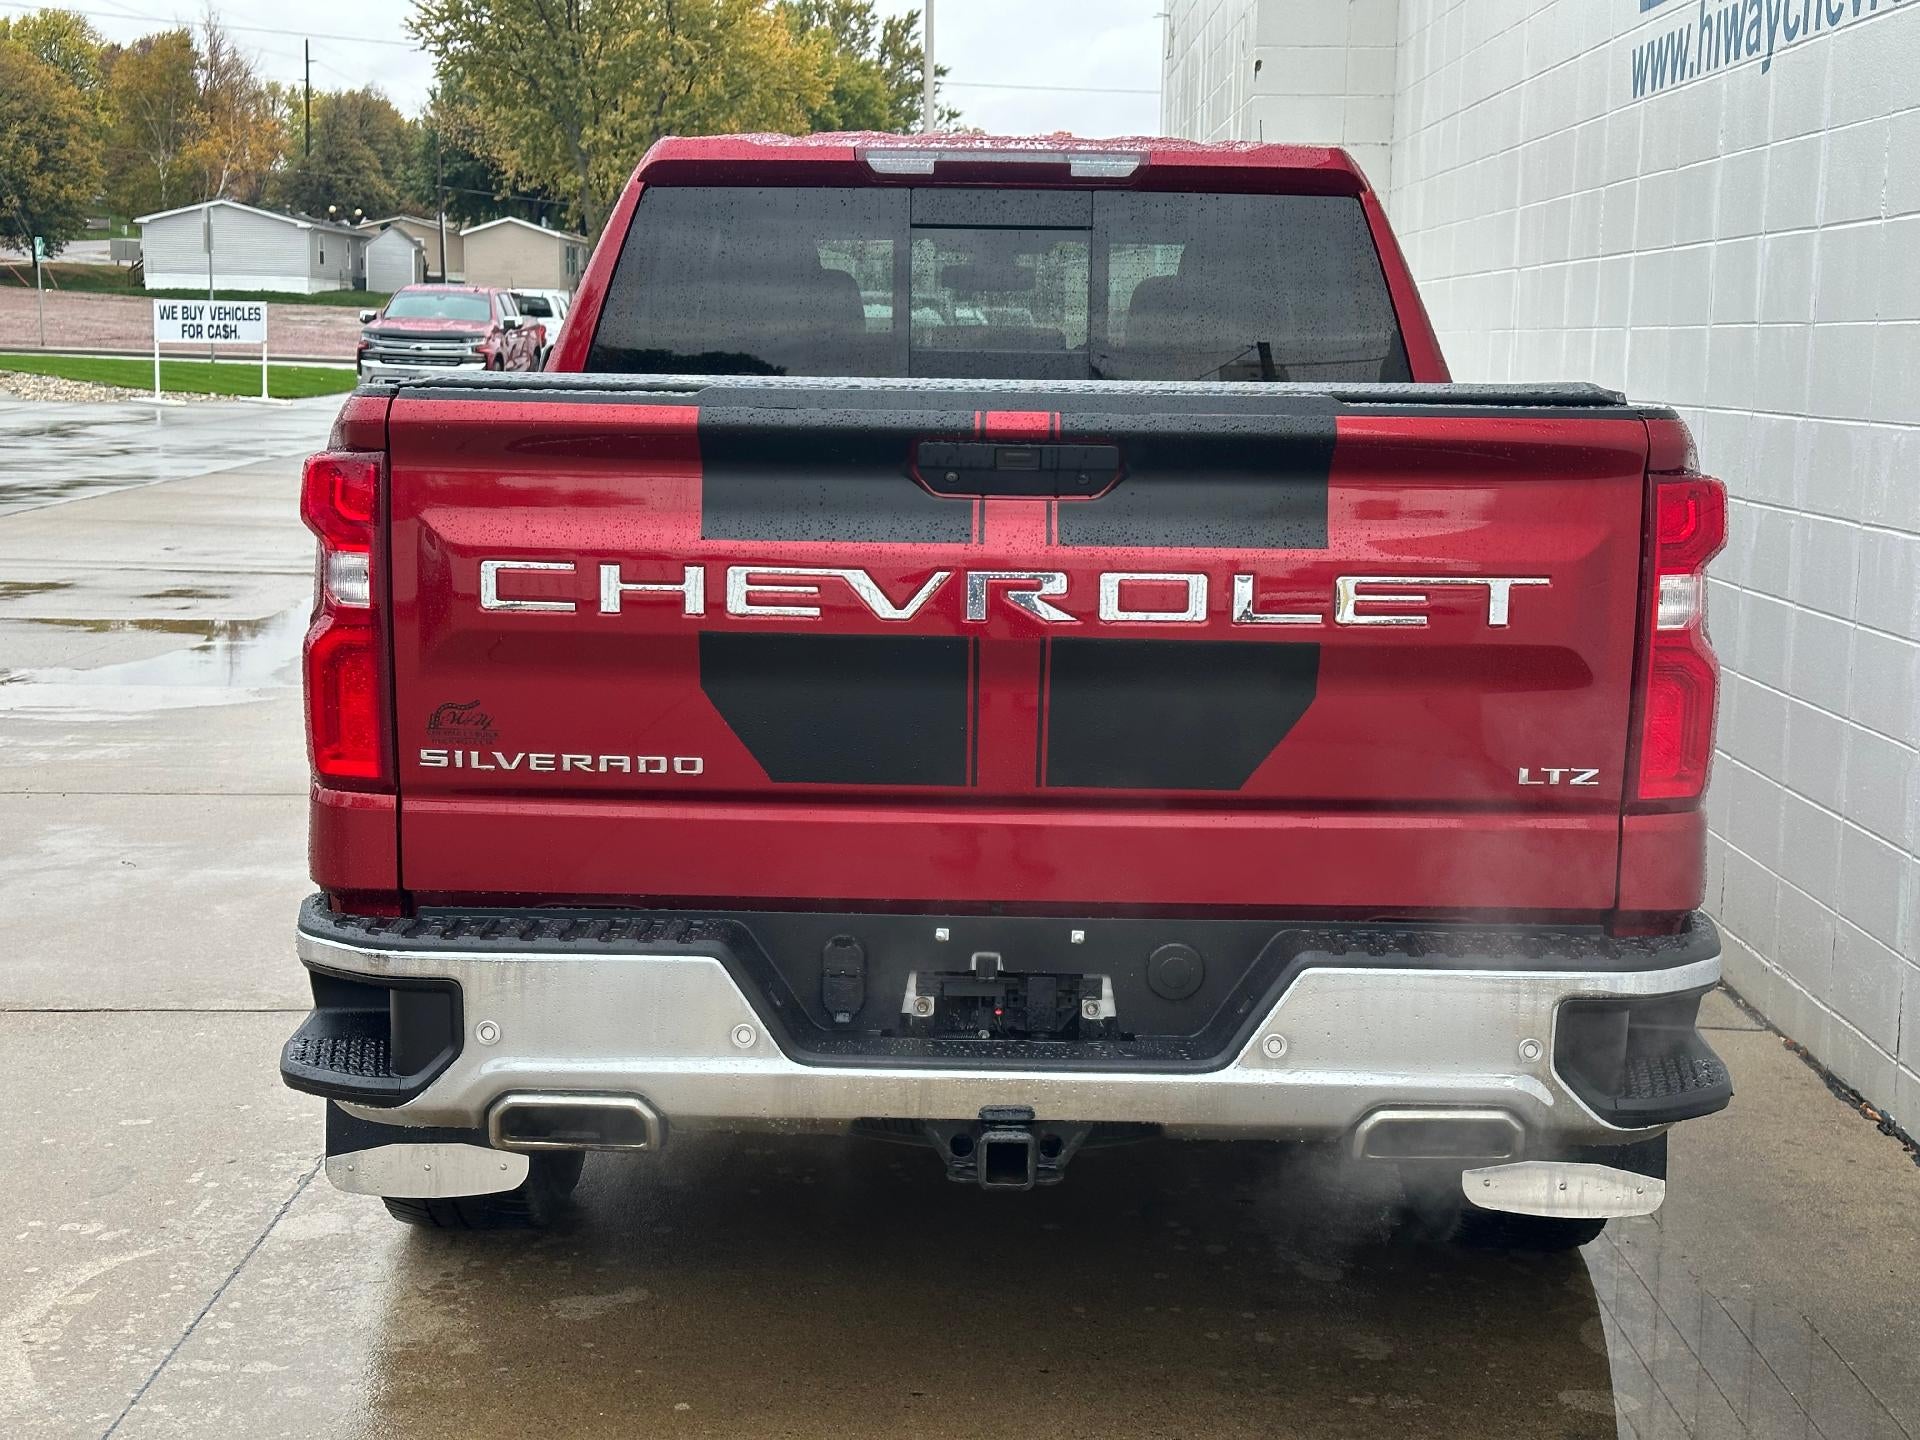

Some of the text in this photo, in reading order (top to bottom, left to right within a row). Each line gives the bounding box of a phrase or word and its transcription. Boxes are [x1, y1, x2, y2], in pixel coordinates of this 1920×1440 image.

[159, 305, 261, 321] WE BUY VEHICLES
[181, 323, 203, 339] FOR
[480, 560, 1551, 626] CHEVROLET
[420, 748, 704, 775] SILVERADO
[1518, 767, 1599, 785] LTZ
